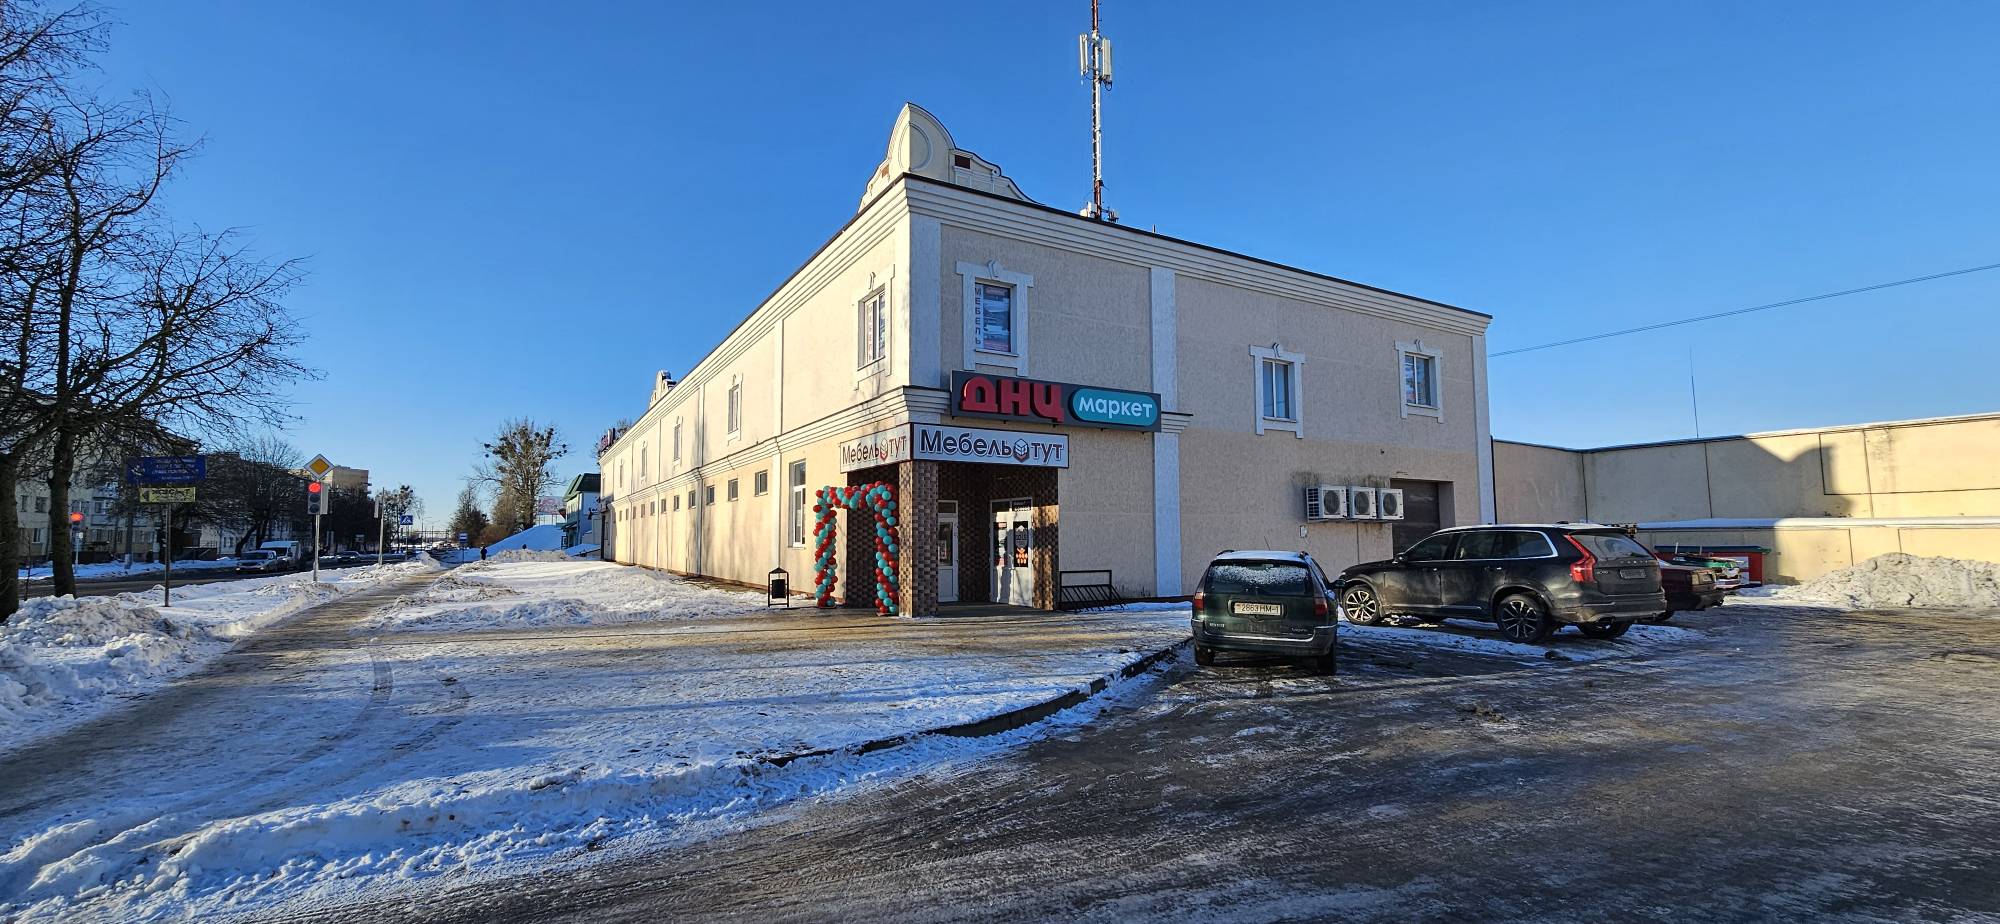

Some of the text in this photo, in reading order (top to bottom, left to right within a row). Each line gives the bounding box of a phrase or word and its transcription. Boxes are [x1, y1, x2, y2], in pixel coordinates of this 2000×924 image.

[960, 376, 1152, 422] ДНЦ маркет
[842, 434, 906, 465] Мебель тут
[920, 429, 1064, 463] Мебель тут
